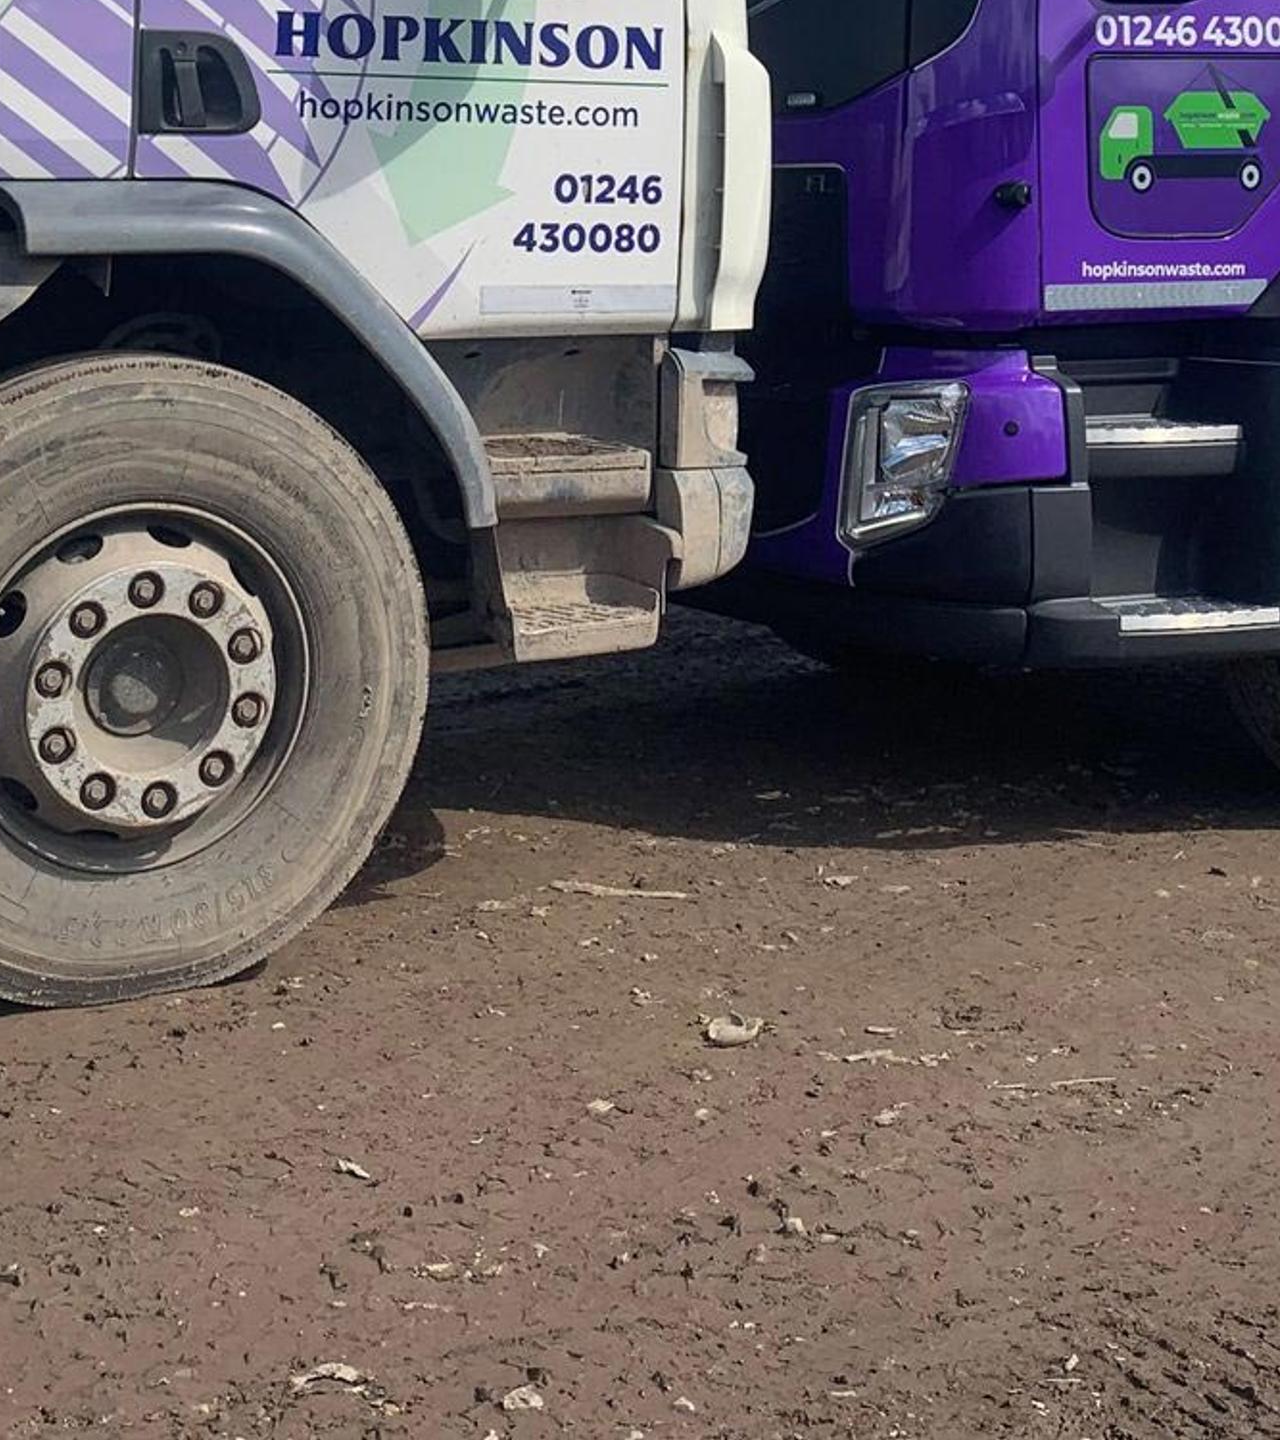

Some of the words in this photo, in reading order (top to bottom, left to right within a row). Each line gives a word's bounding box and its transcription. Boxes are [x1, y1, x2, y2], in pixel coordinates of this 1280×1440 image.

[274, 10, 664, 70] HOPKINSON
[1095, 15, 1198, 48] 01246
[298, 92, 639, 128] hopkinsonwaste.com
[553, 174, 663, 205] 01246
[513, 222, 661, 253] 430080
[1081, 261, 1246, 279] hopkinsonwaste.com
